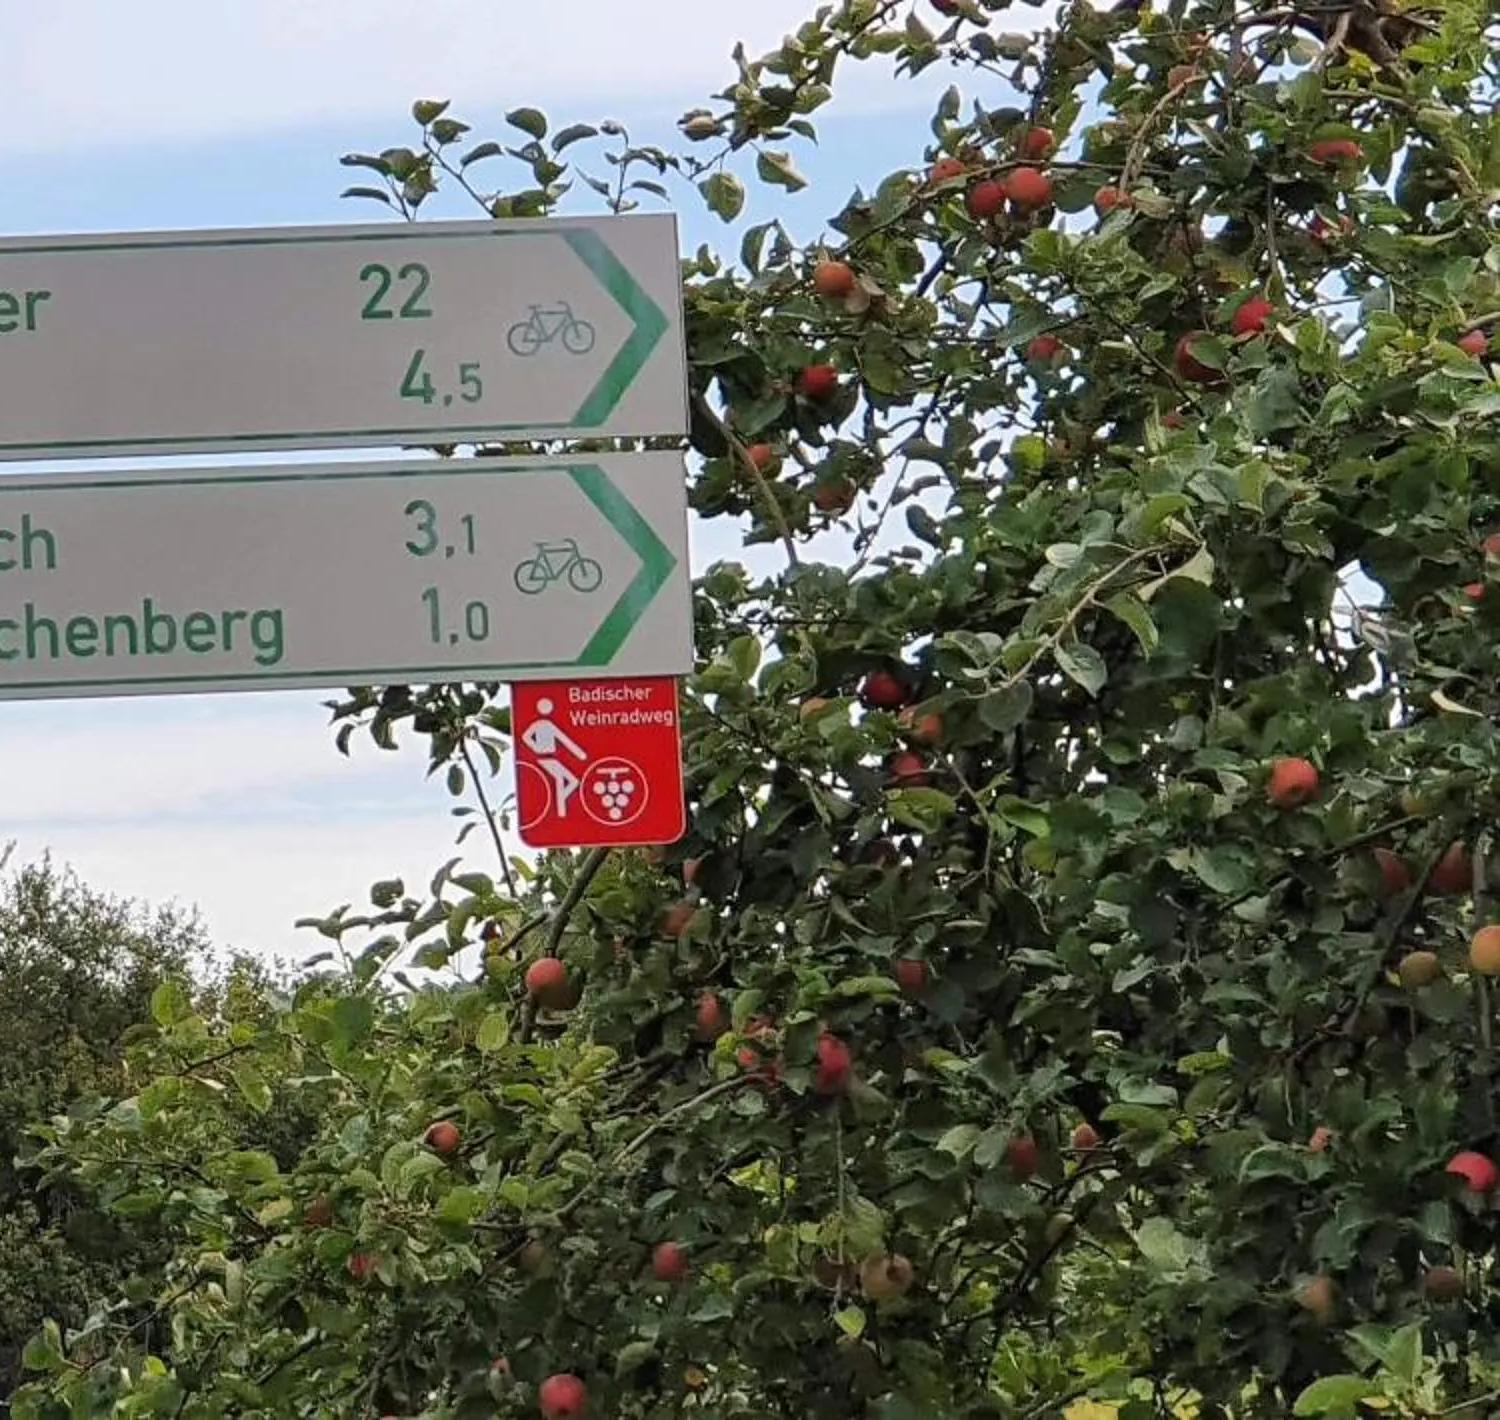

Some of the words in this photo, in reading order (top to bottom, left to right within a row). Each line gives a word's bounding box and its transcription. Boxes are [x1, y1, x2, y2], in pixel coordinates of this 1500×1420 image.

[359, 262, 433, 319] 22
[400, 348, 483, 407] 4,5
[404, 499, 475, 558] 3,1
[422, 585, 489, 646] 1,0
[568, 684, 653, 703] Badischer
[569, 708, 674, 727] Weinradweg
